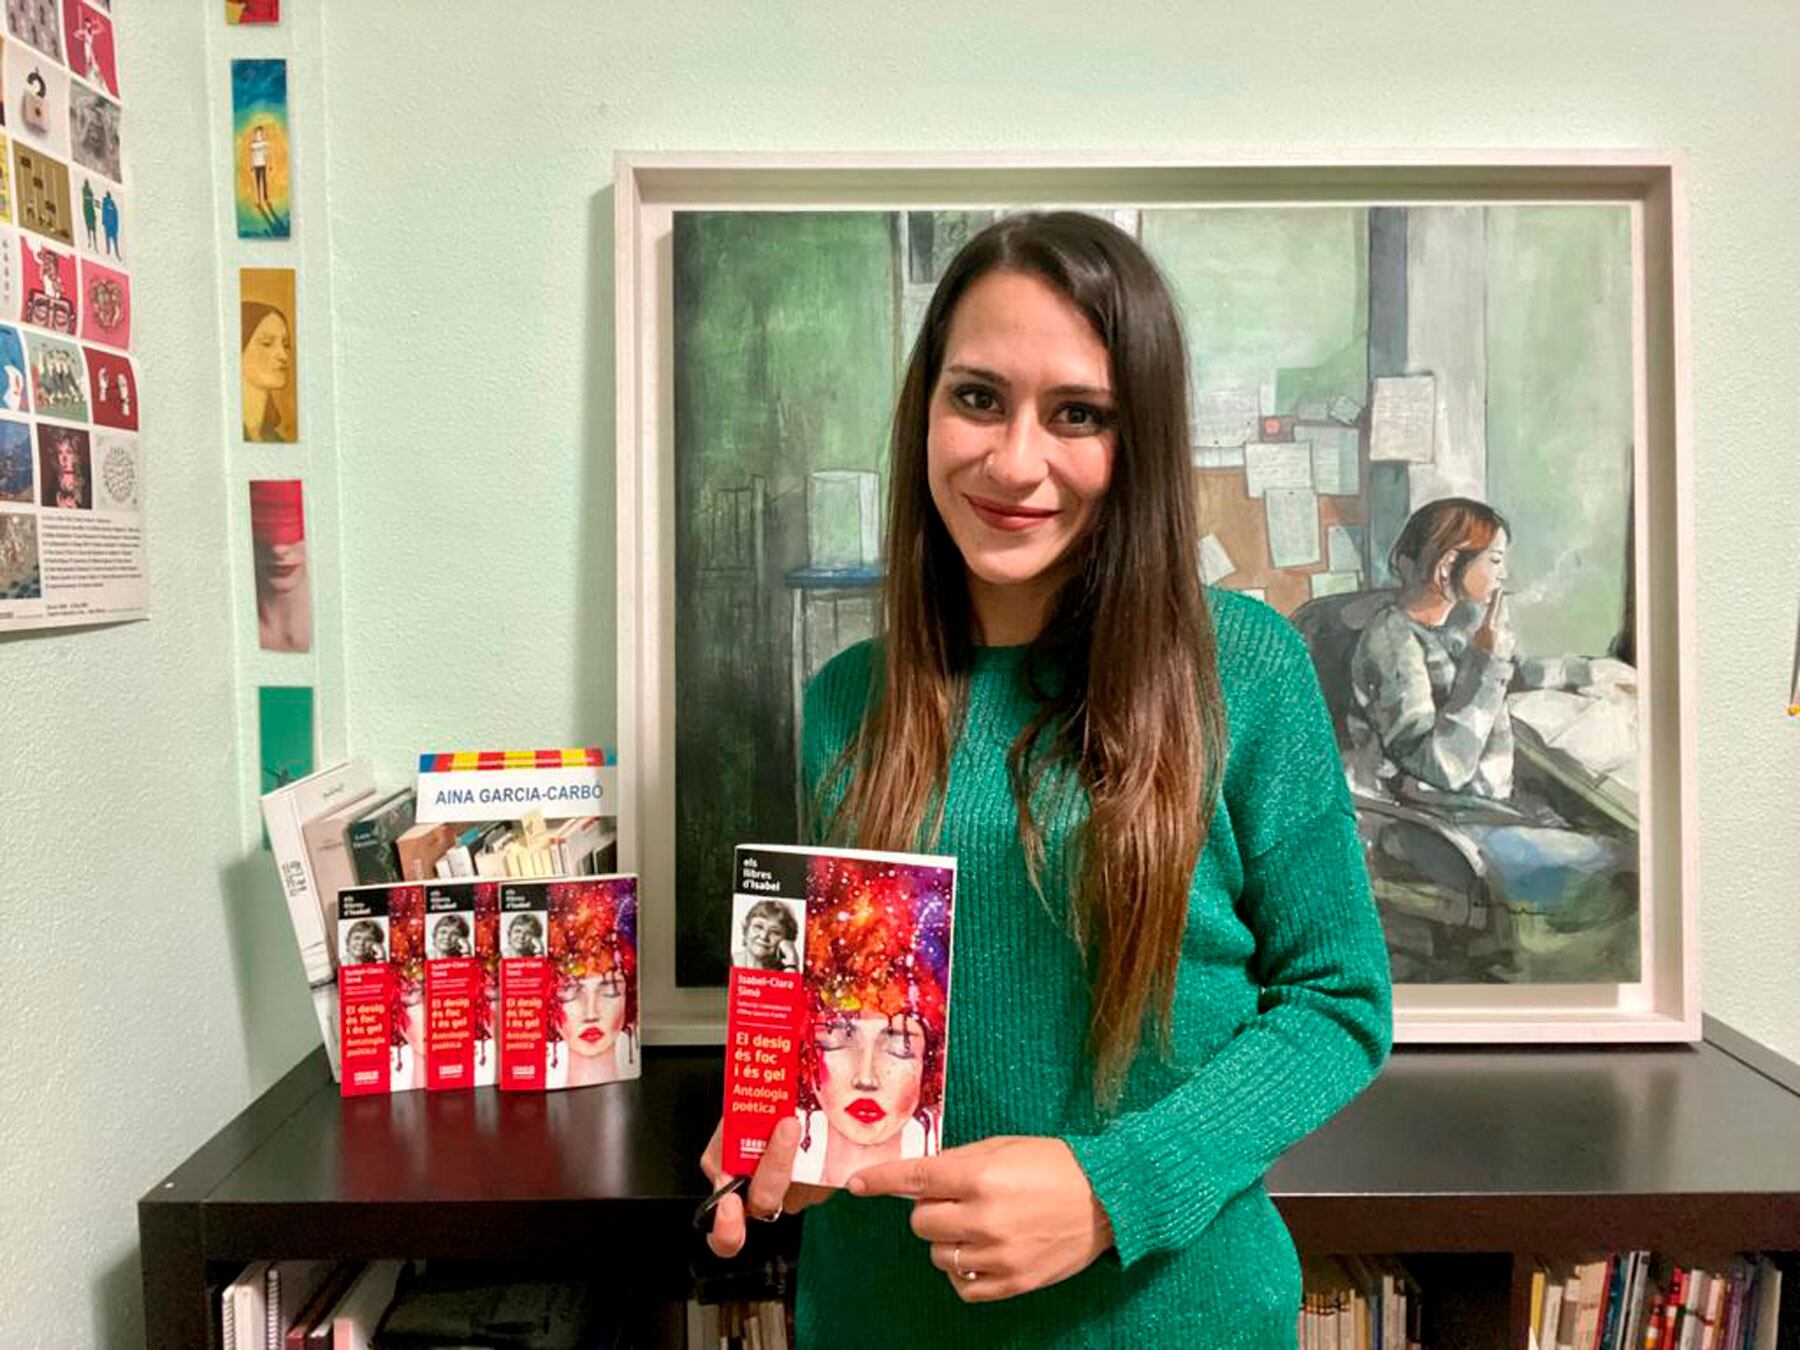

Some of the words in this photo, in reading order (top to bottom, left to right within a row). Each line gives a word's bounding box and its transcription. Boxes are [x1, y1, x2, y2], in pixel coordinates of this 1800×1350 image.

[435, 788, 475, 805] AINA
[743, 857, 758, 868] els
[743, 868, 772, 880] llibres
[743, 879, 780, 891] d'Isabel
[738, 975, 794, 989] Isabel-Clara
[736, 1032, 749, 1045] El
[753, 1033, 791, 1053] desig
[734, 1048, 751, 1062] és
[755, 1049, 777, 1065] foc
[743, 1064, 759, 1078] és
[763, 1067, 786, 1083] gel
[732, 1083, 788, 1102] Antologia
